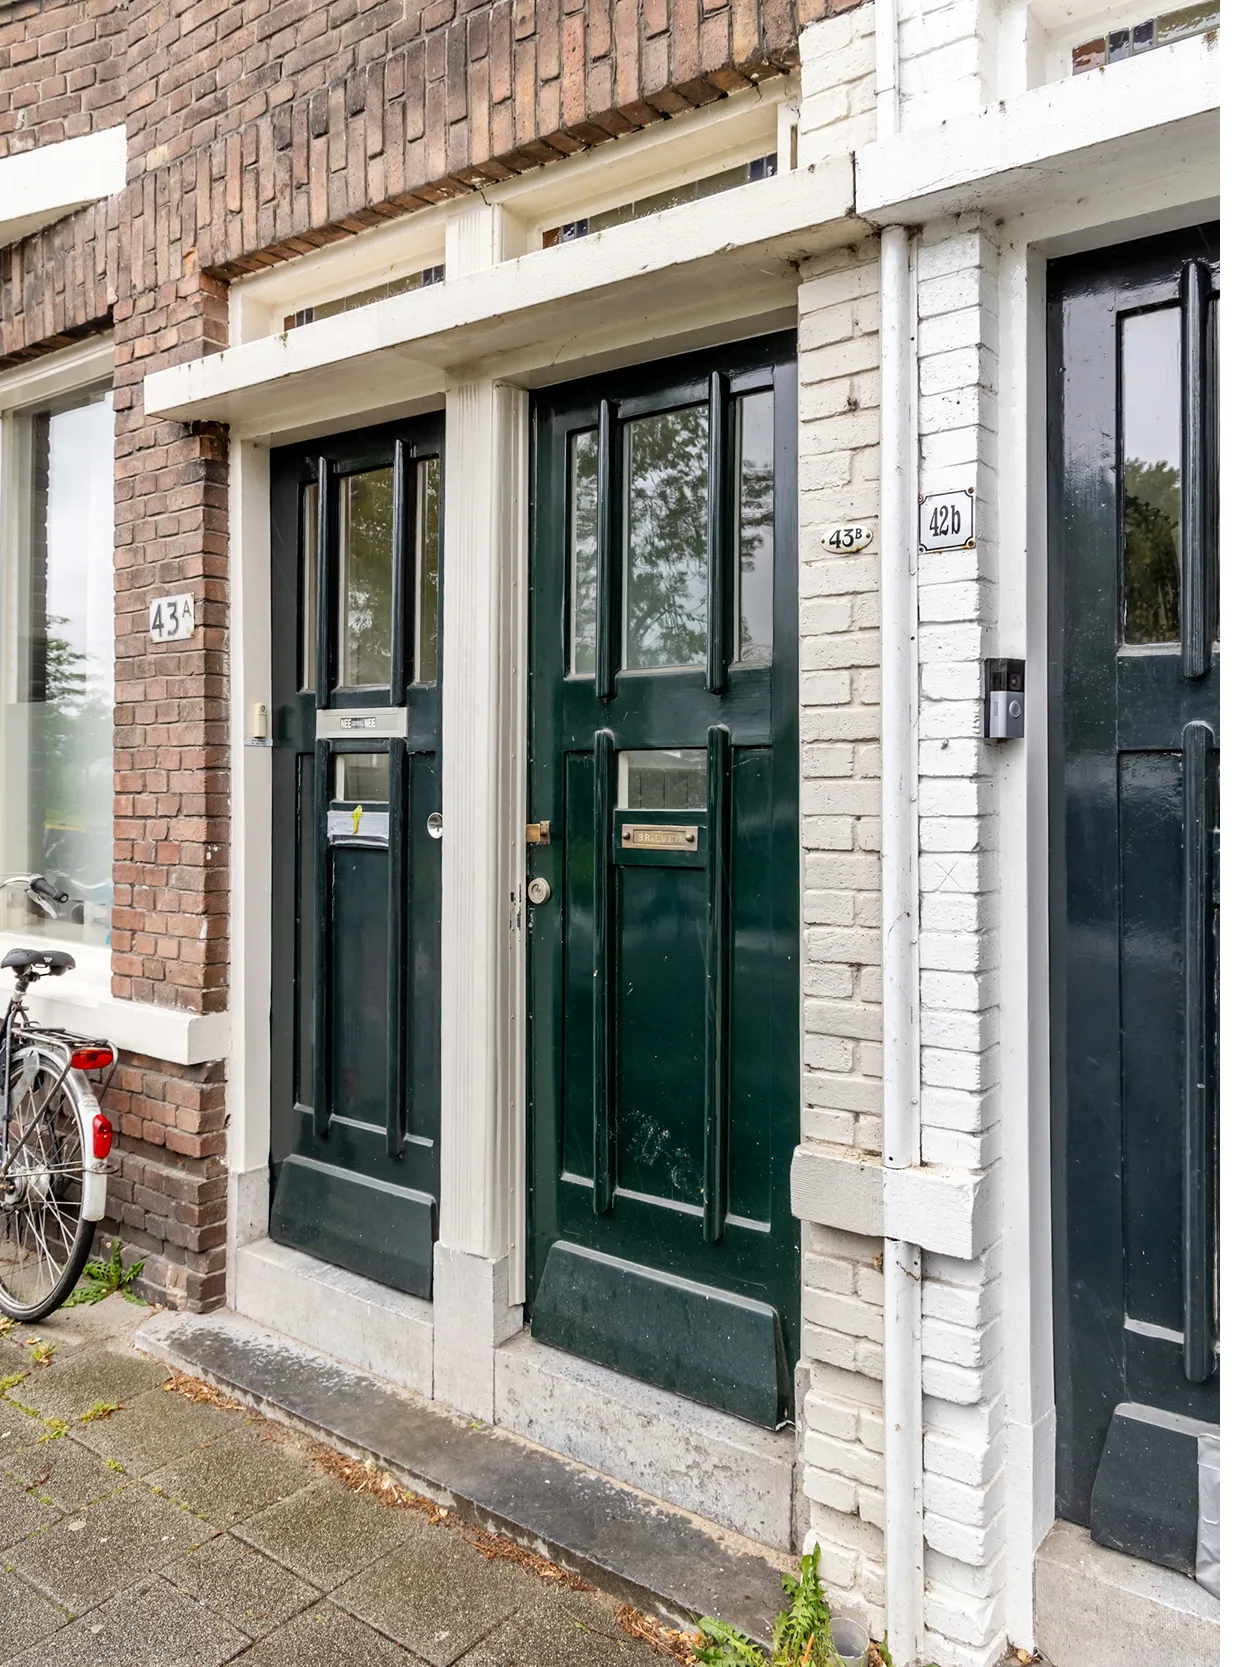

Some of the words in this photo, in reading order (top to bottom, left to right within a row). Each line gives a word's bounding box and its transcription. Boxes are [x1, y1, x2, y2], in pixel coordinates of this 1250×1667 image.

[929, 504, 961, 537] 42b
[829, 528, 863, 549] 43B
[151, 599, 192, 638] 43A
